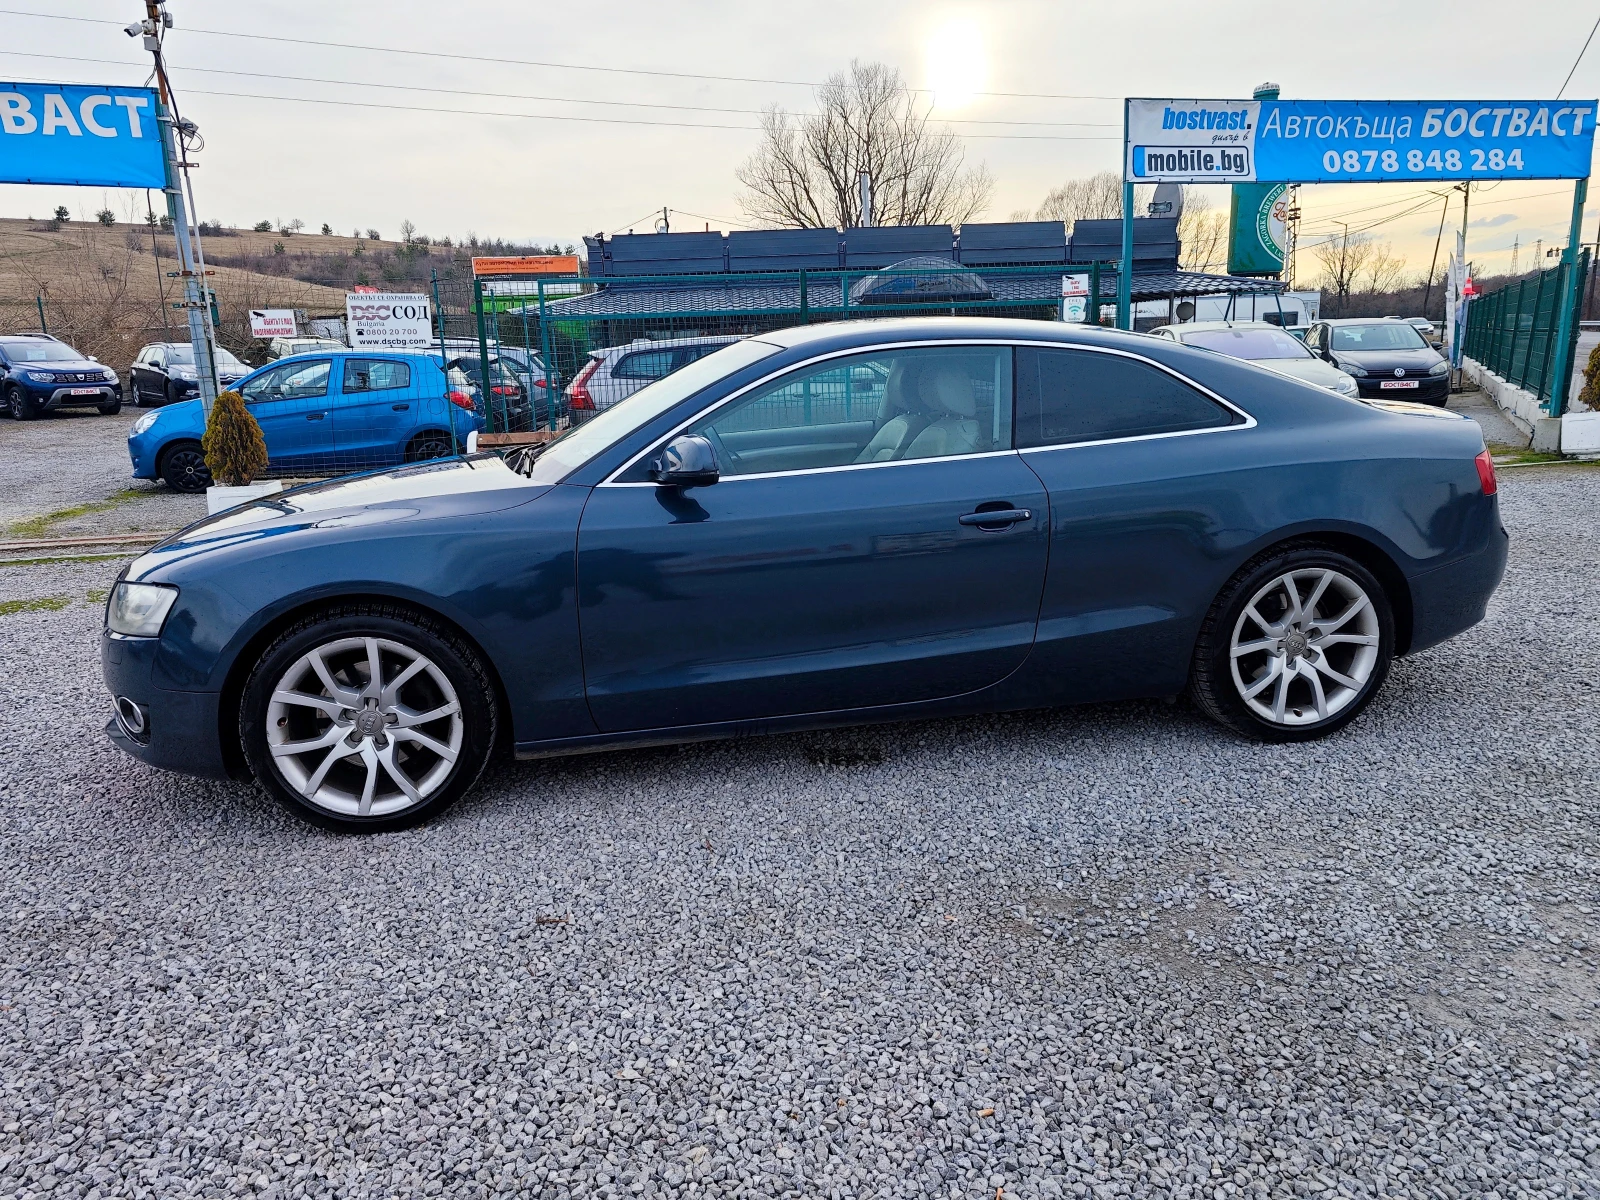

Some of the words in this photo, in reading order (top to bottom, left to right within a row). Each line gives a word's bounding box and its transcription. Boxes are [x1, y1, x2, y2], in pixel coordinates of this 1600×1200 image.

[1261, 107, 1414, 144] Автокъща
[1419, 107, 1593, 138] БОСТВАСТ
[1147, 149, 1245, 173] mobile.bg
[1322, 149, 1400, 173] 0878
[1406, 149, 1463, 172] 848
[1469, 148, 1525, 171] 284
[1259, 213, 1273, 247] ZAGORKA
[350, 305, 391, 321] DSC
[392, 305, 430, 322] СОД
[358, 338, 427, 346] www.dscbg.com
[366, 328, 387, 336] 0800
[389, 328, 400, 336] 20
